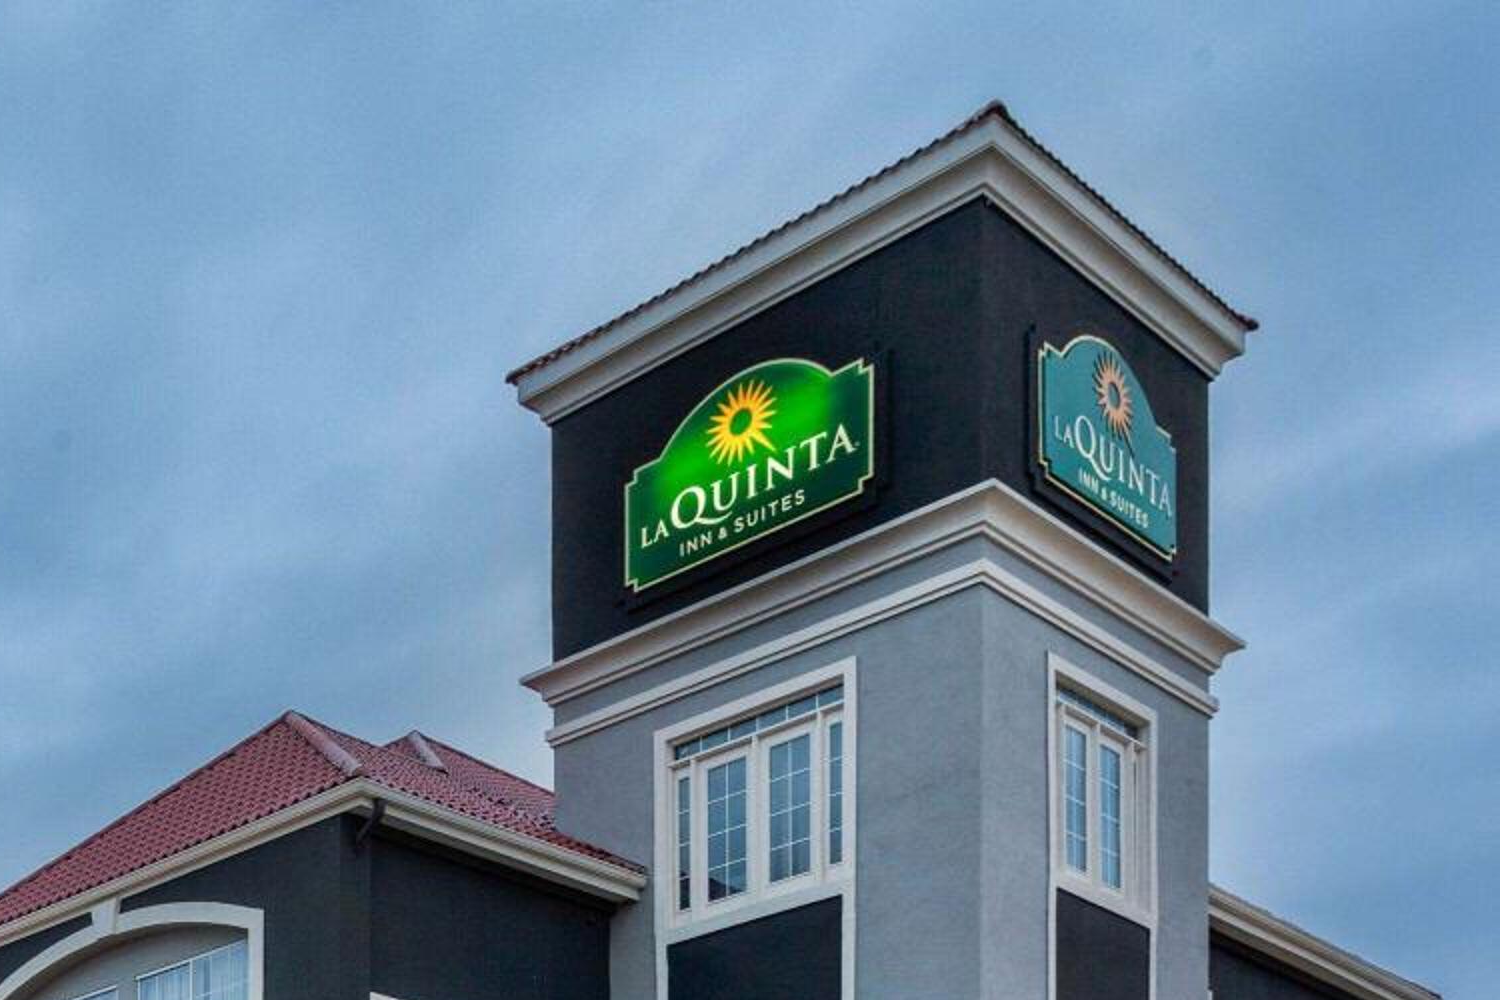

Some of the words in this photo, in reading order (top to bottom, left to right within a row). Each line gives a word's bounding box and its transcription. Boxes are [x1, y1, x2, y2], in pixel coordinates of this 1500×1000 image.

[640, 519, 669, 548] LA
[671, 424, 856, 530] QUINTA
[1054, 415, 1074, 449] LA
[1075, 415, 1172, 518] QUINTA
[1079, 468, 1099, 495] INN
[1110, 489, 1150, 529] SUITES
[679, 531, 713, 556] INN
[717, 527, 728, 540] &
[734, 489, 806, 532] SUITES
